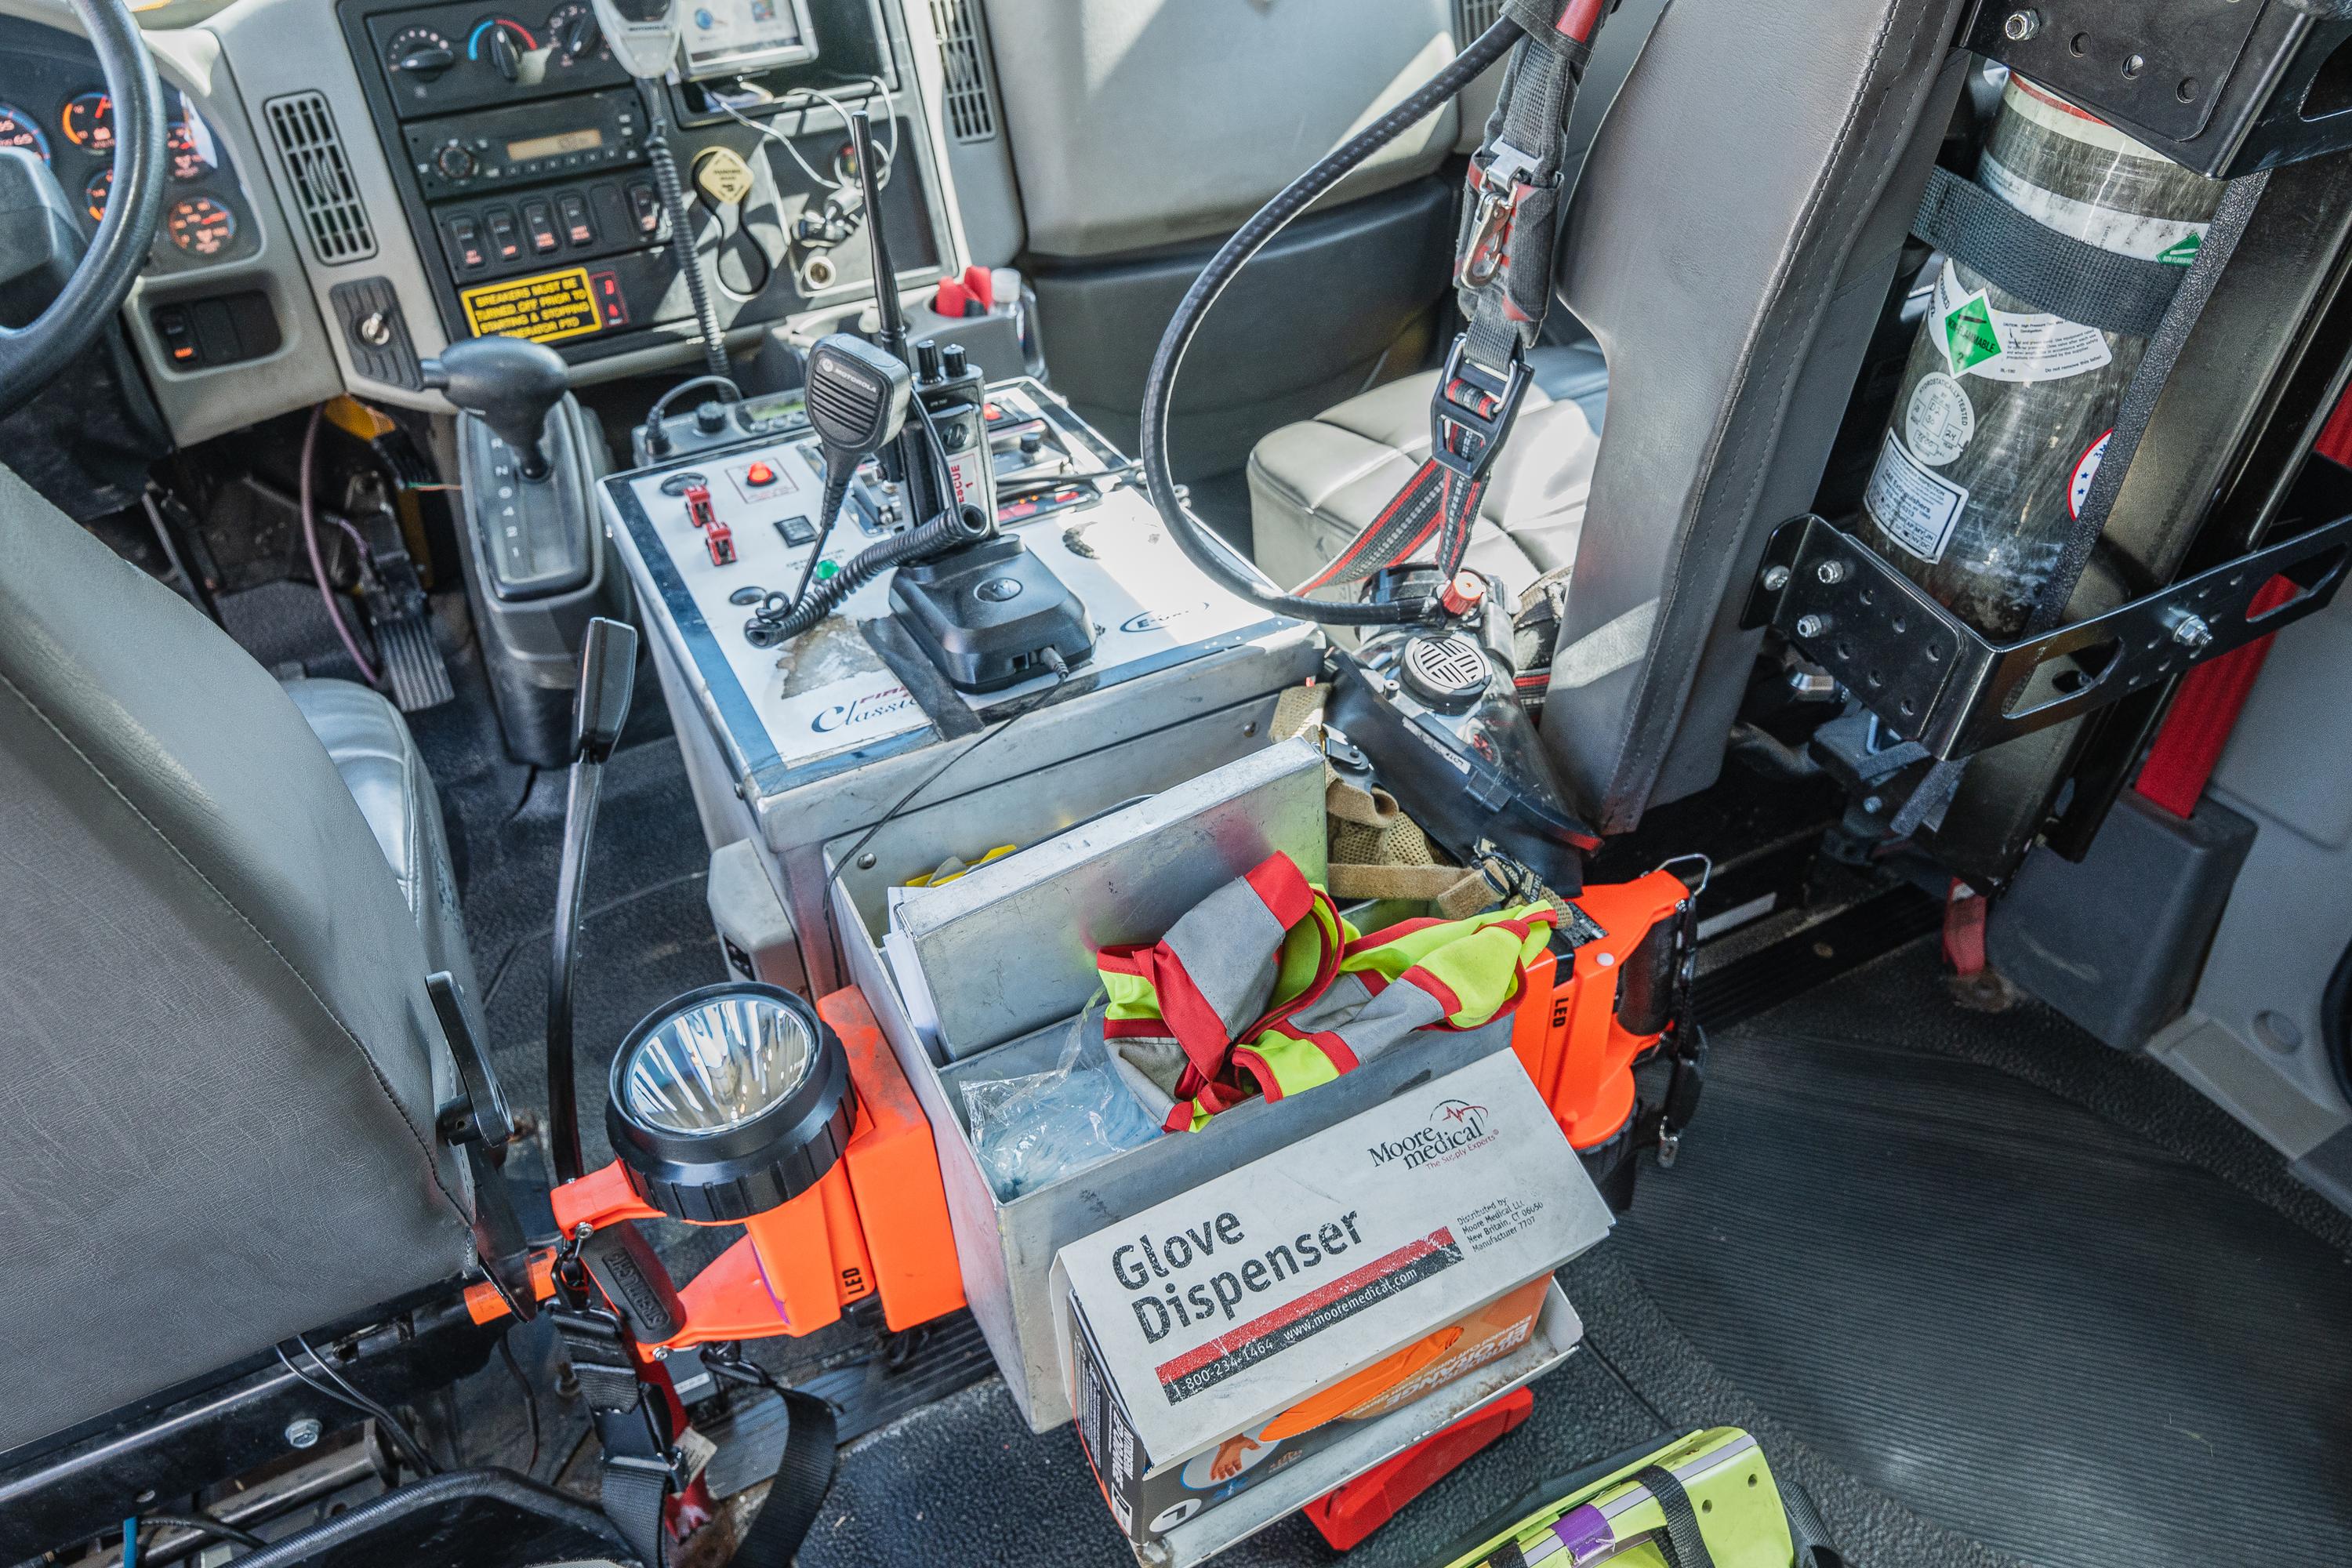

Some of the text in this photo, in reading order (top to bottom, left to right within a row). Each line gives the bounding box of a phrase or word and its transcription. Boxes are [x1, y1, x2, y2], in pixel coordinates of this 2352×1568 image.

[517, 298, 539, 313] OFF
[539, 292, 572, 307] PRIOR
[571, 289, 587, 301] TO
[531, 280, 561, 296] MUST
[561, 277, 578, 290] BE
[480, 301, 590, 334] STARTING & STOPPING
[1947, 317, 1996, 354] NON-FLAMMABLE
[1957, 352, 1965, 364] 2
[2061, 361, 2079, 371] remove
[836, 368, 877, 393] MOTOROLA
[1958, 398, 1969, 426] TESTED
[951, 464, 965, 503] ESCUE
[1552, 996, 1569, 1029] LED
[1367, 1127, 1434, 1167] Moore
[1403, 1116, 1485, 1171] medical
[1425, 1160, 1441, 1171] The
[1457, 1200, 1497, 1226] Distributed
[1462, 1219, 1485, 1235] Moore
[1484, 1205, 1513, 1225] Medical
[1467, 1232, 1483, 1243] New
[1483, 1219, 1512, 1236] Britain,
[1512, 1213, 1521, 1223] CT
[1112, 1210, 1245, 1290] Glove
[1472, 1215, 1536, 1253] Manufacturer 7707
[842, 1266, 865, 1296] LED
[1131, 1210, 1363, 1345] Dispenser
[1283, 1268, 1417, 1341] www.mooremedical.com
[1383, 1341, 1495, 1409] ORANGE
[1112, 1428, 1124, 1490] ORANGE
